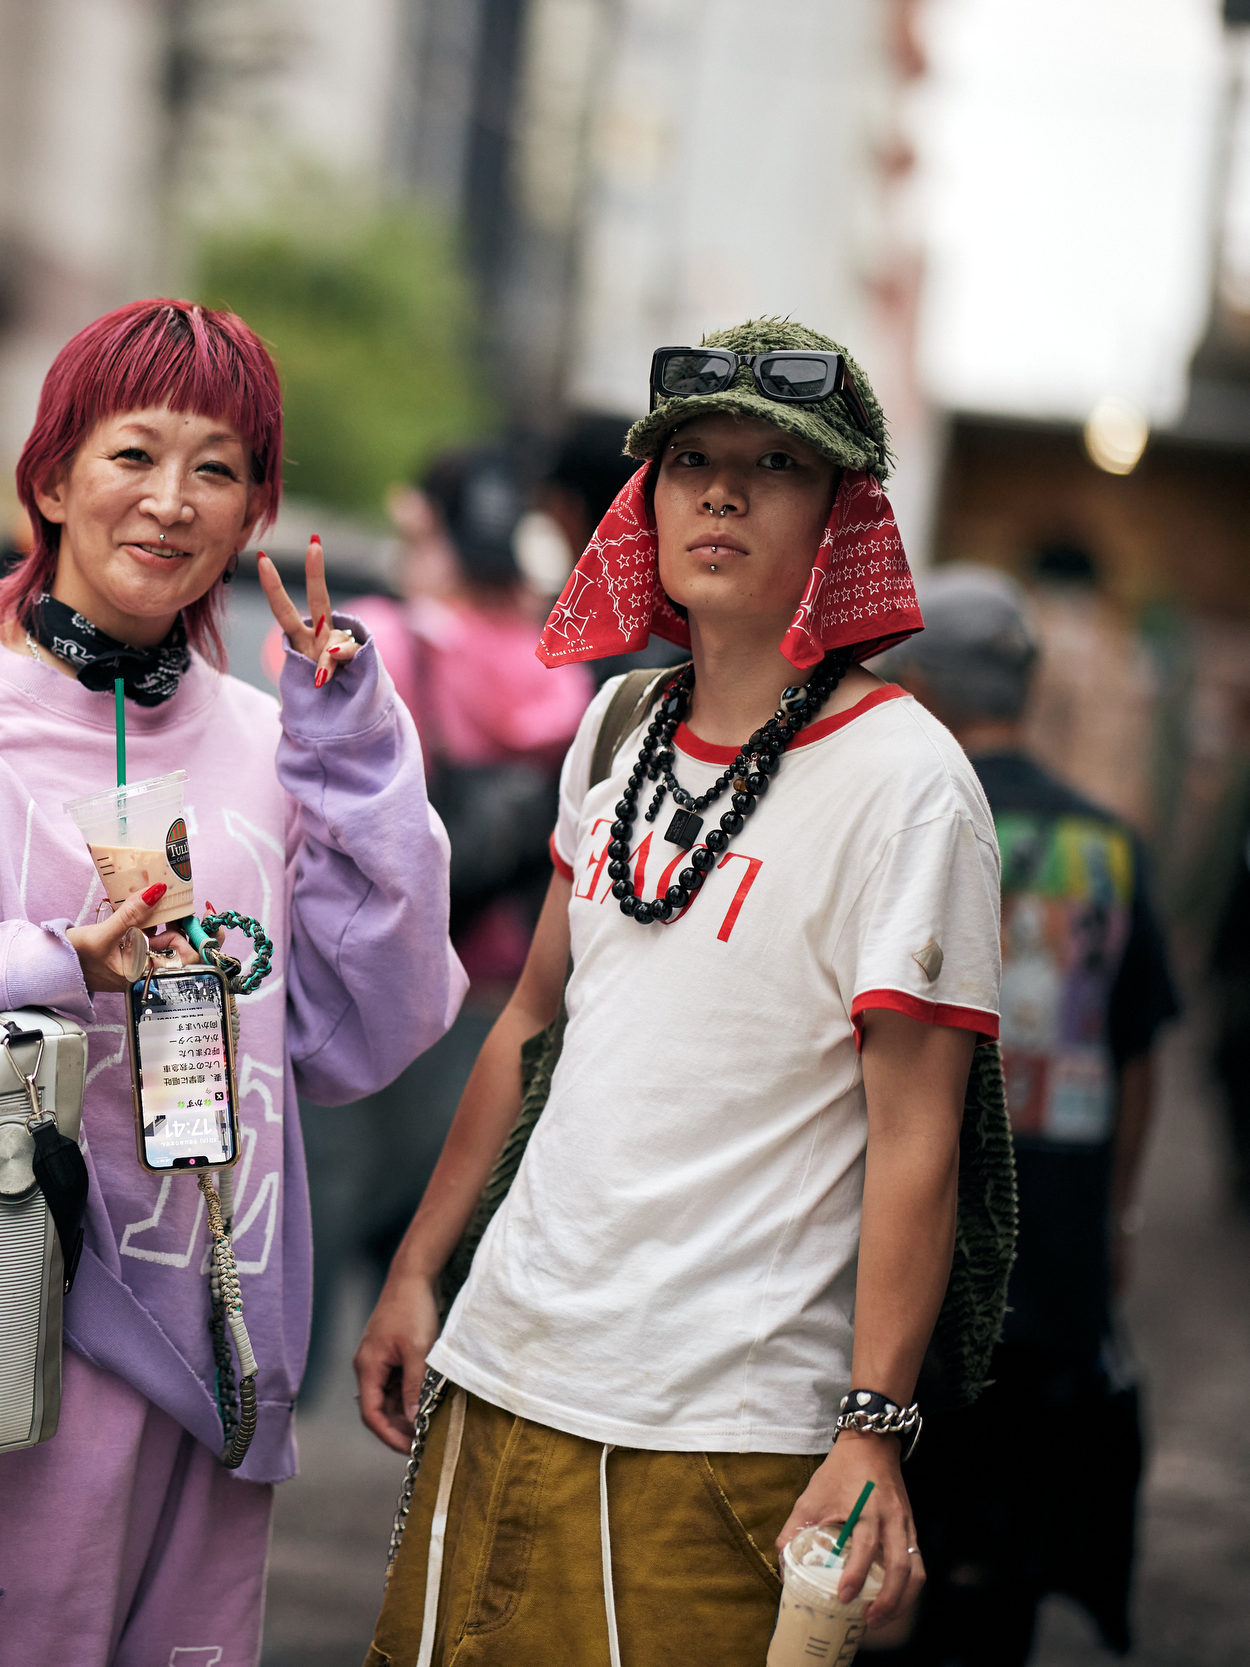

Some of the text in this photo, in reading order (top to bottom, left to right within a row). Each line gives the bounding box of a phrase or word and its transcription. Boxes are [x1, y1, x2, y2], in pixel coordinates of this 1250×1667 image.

[575, 818, 763, 943] LOVE
[177, 1020, 218, 1031] 向かいます
[169, 1033, 219, 1045] がんセンター
[179, 1047, 220, 1058] 呼びました
[163, 1060, 220, 1073] したので救急車
[164, 1118, 212, 1138] 17:41
